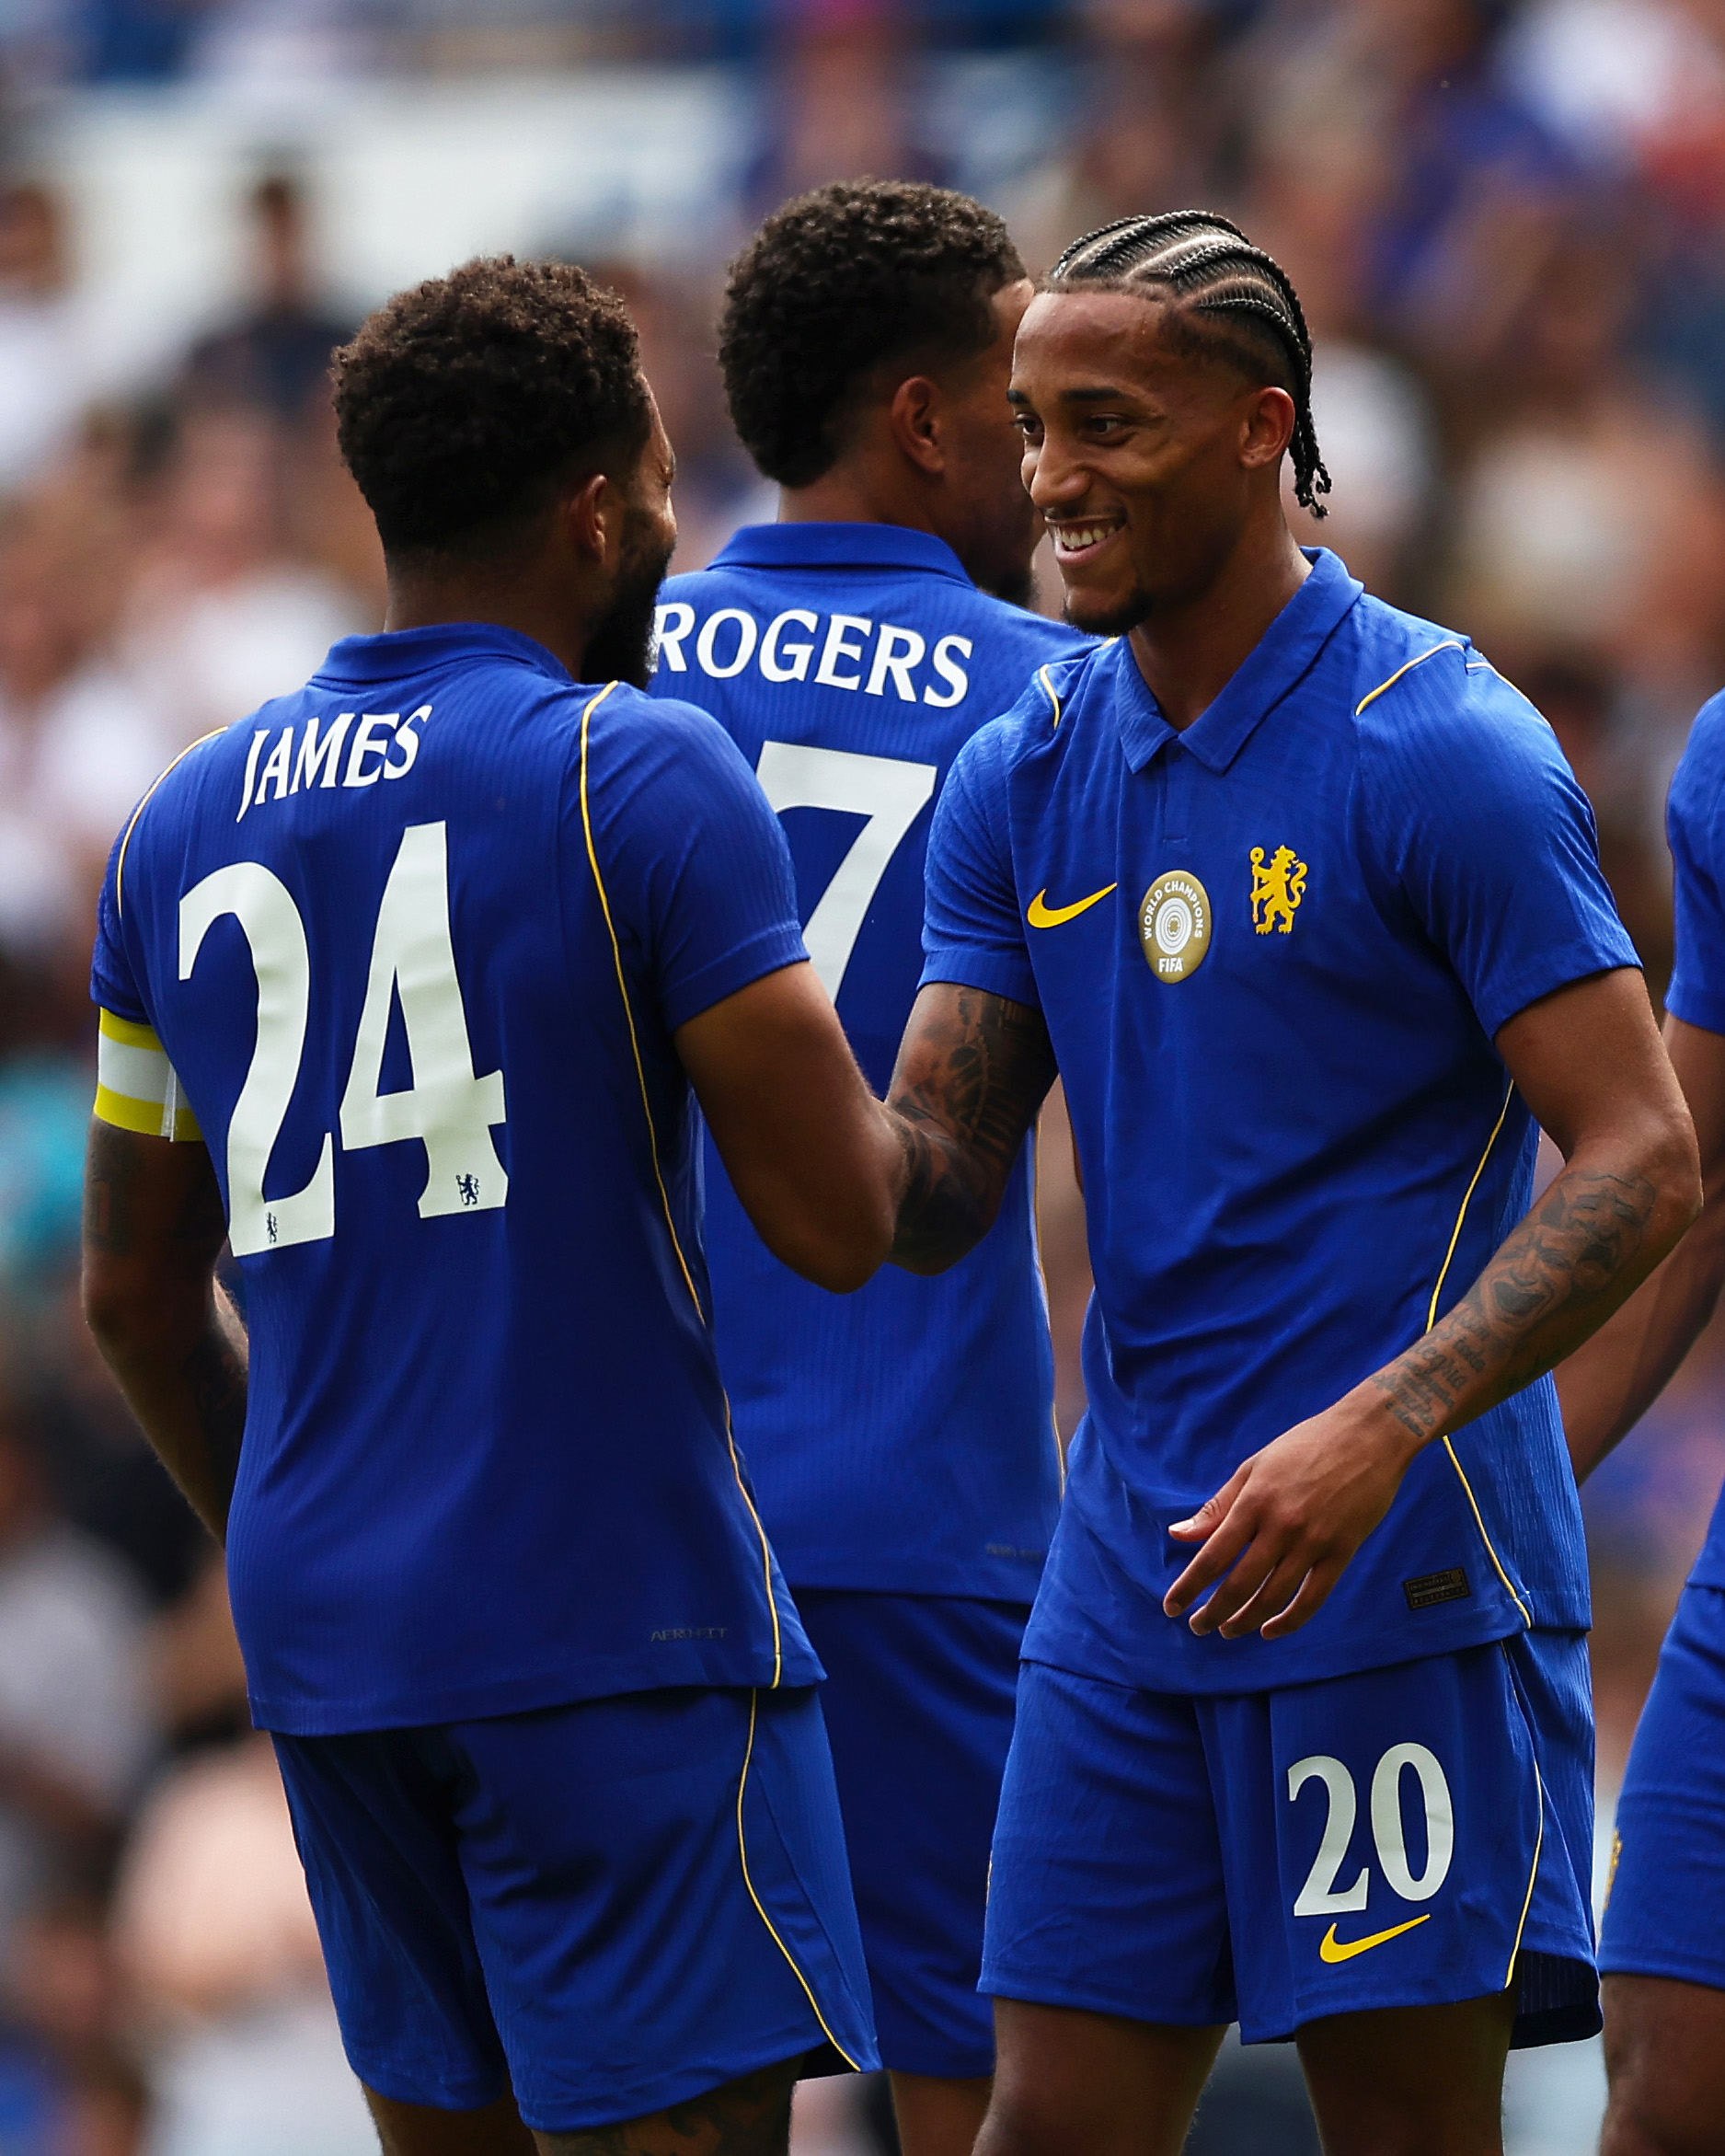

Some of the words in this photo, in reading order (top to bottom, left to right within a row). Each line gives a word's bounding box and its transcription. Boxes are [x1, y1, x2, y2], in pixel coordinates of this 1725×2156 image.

[652, 603, 973, 709] ROGERS
[236, 705, 432, 824] JAMES
[755, 740, 938, 1008] 7
[1144, 889, 1163, 940] WORLD
[1164, 880, 1205, 939] CHAMPIONS
[1157, 957, 1184, 973] FIFA
[178, 820, 509, 1258] 24
[1287, 1742, 1455, 1918] 20
